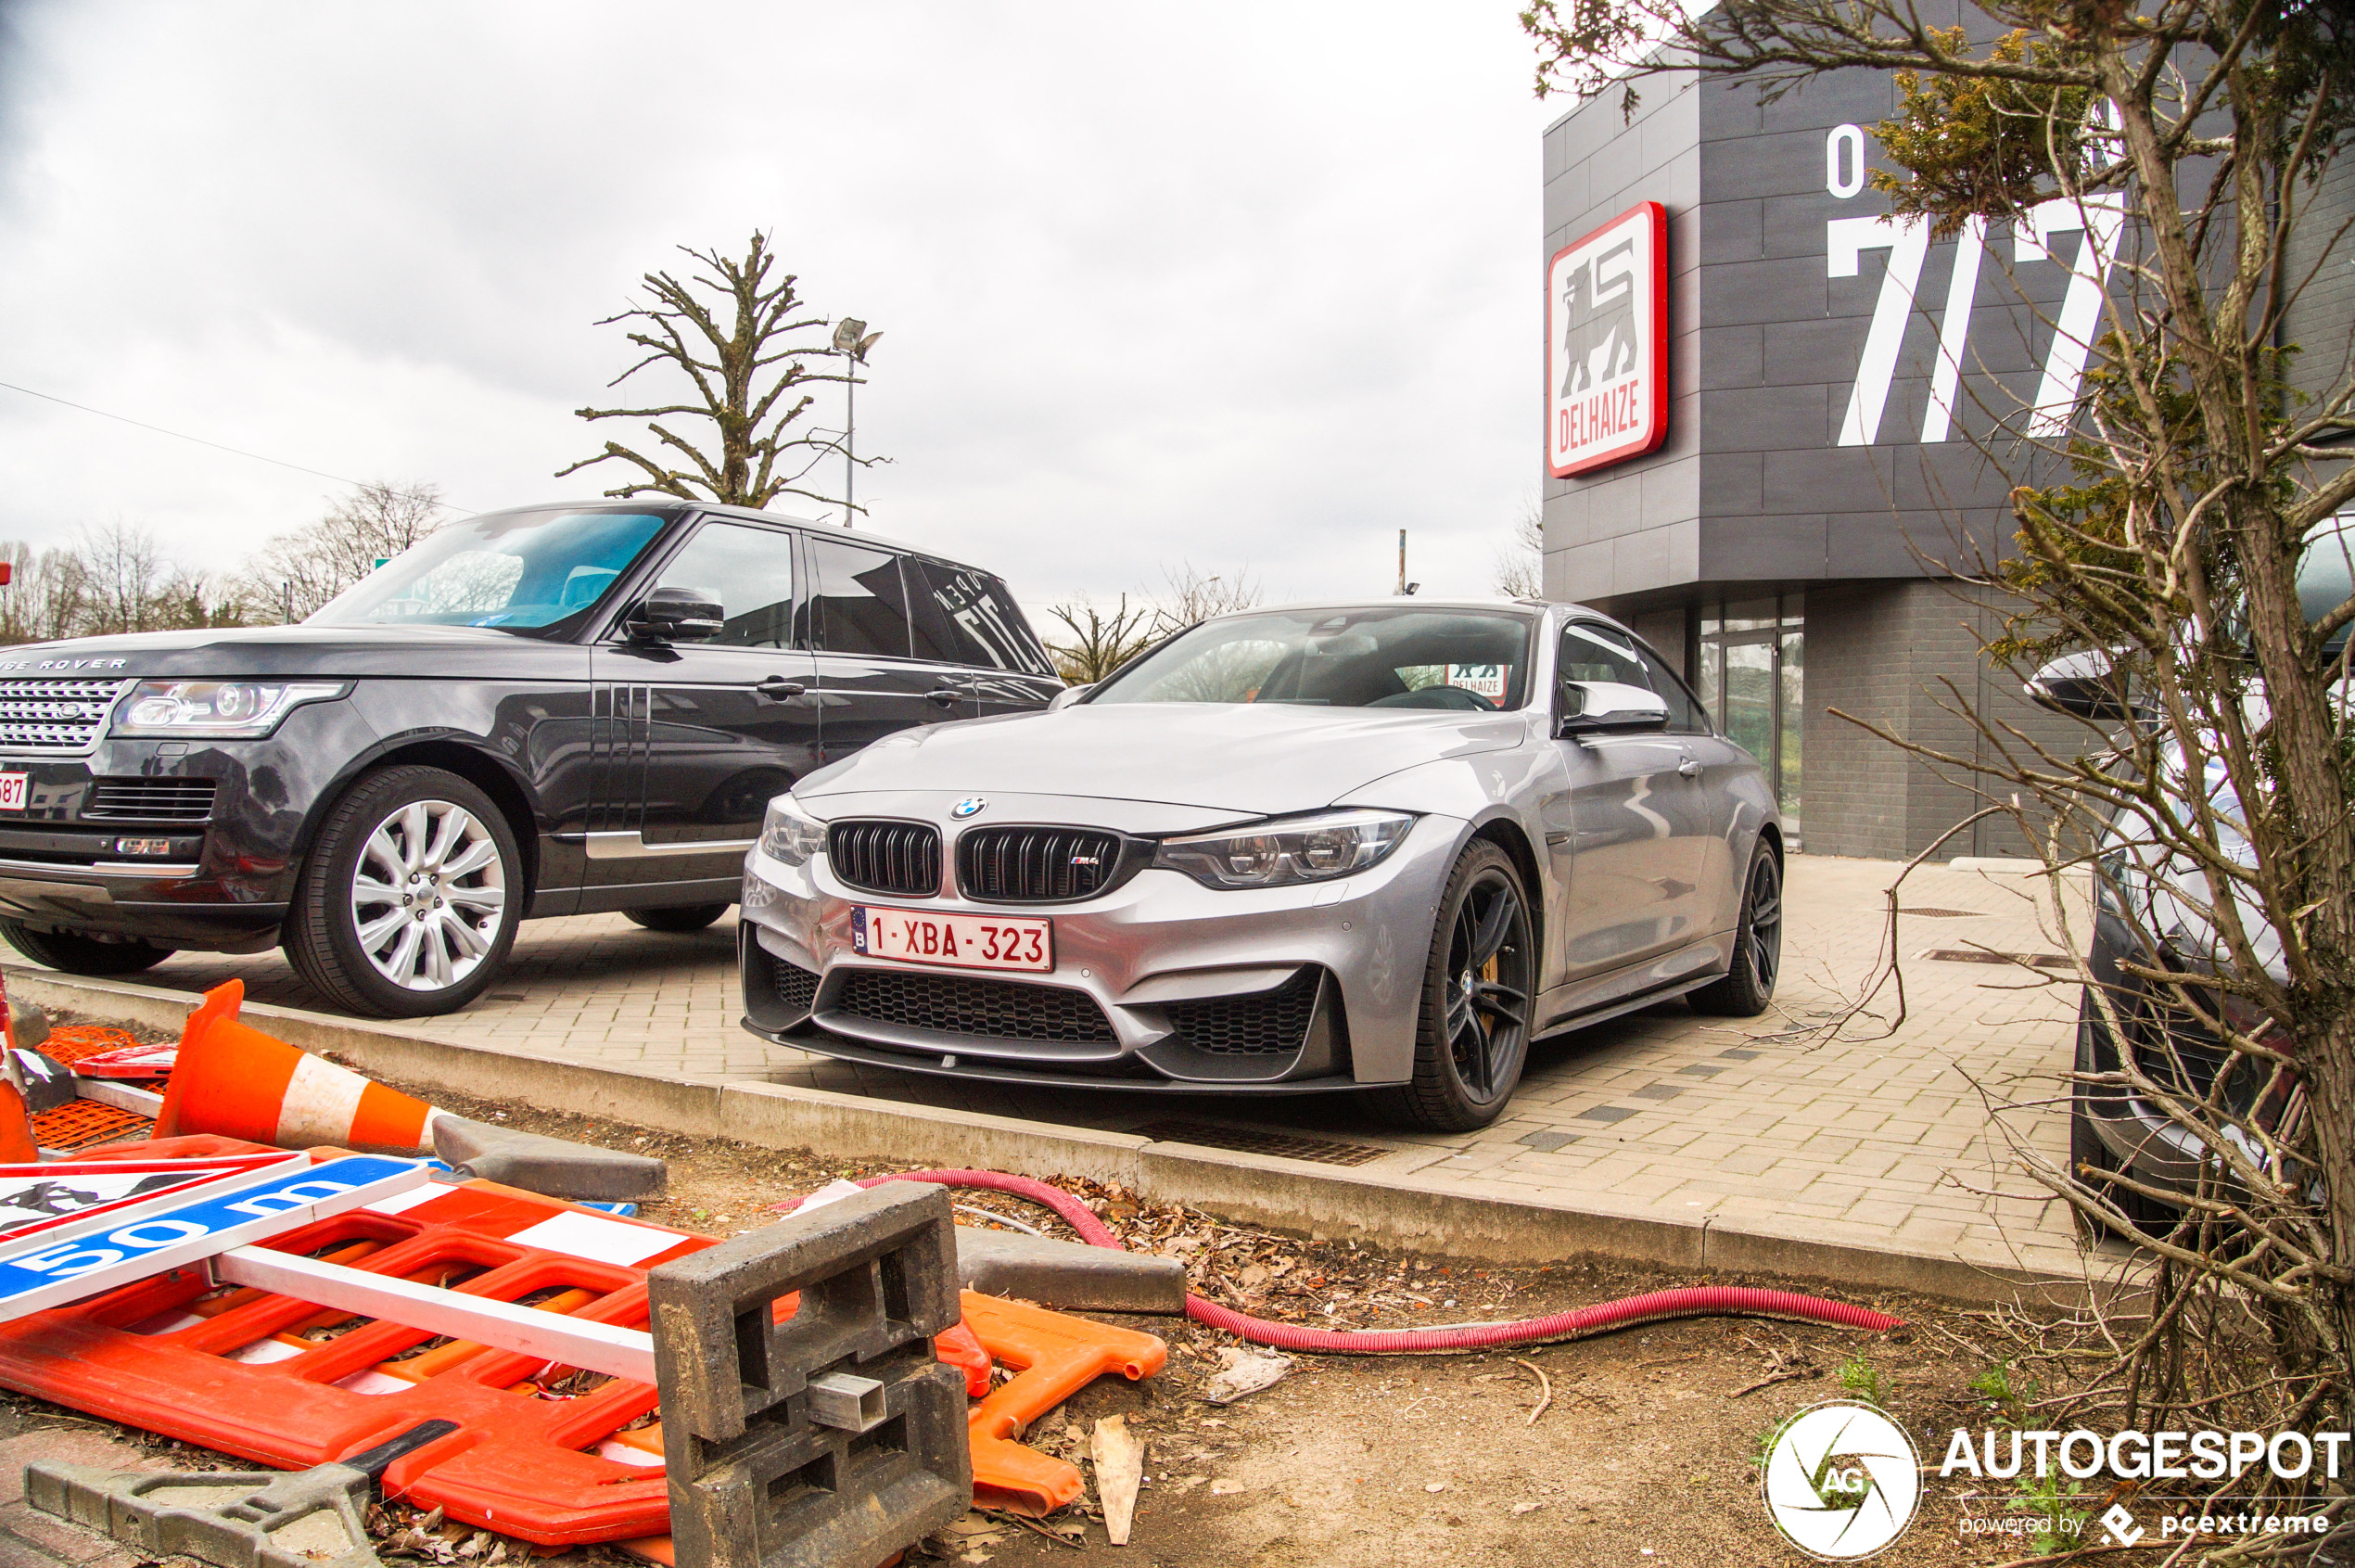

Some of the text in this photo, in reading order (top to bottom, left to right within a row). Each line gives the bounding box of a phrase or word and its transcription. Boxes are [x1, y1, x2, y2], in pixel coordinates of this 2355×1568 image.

[1560, 379, 1638, 453] DELHAIZE
[39, 659, 126, 669] ROVER
[0, 779, 23, 803] 87
[855, 932, 865, 947] B
[7, 1180, 358, 1276] 50 m
